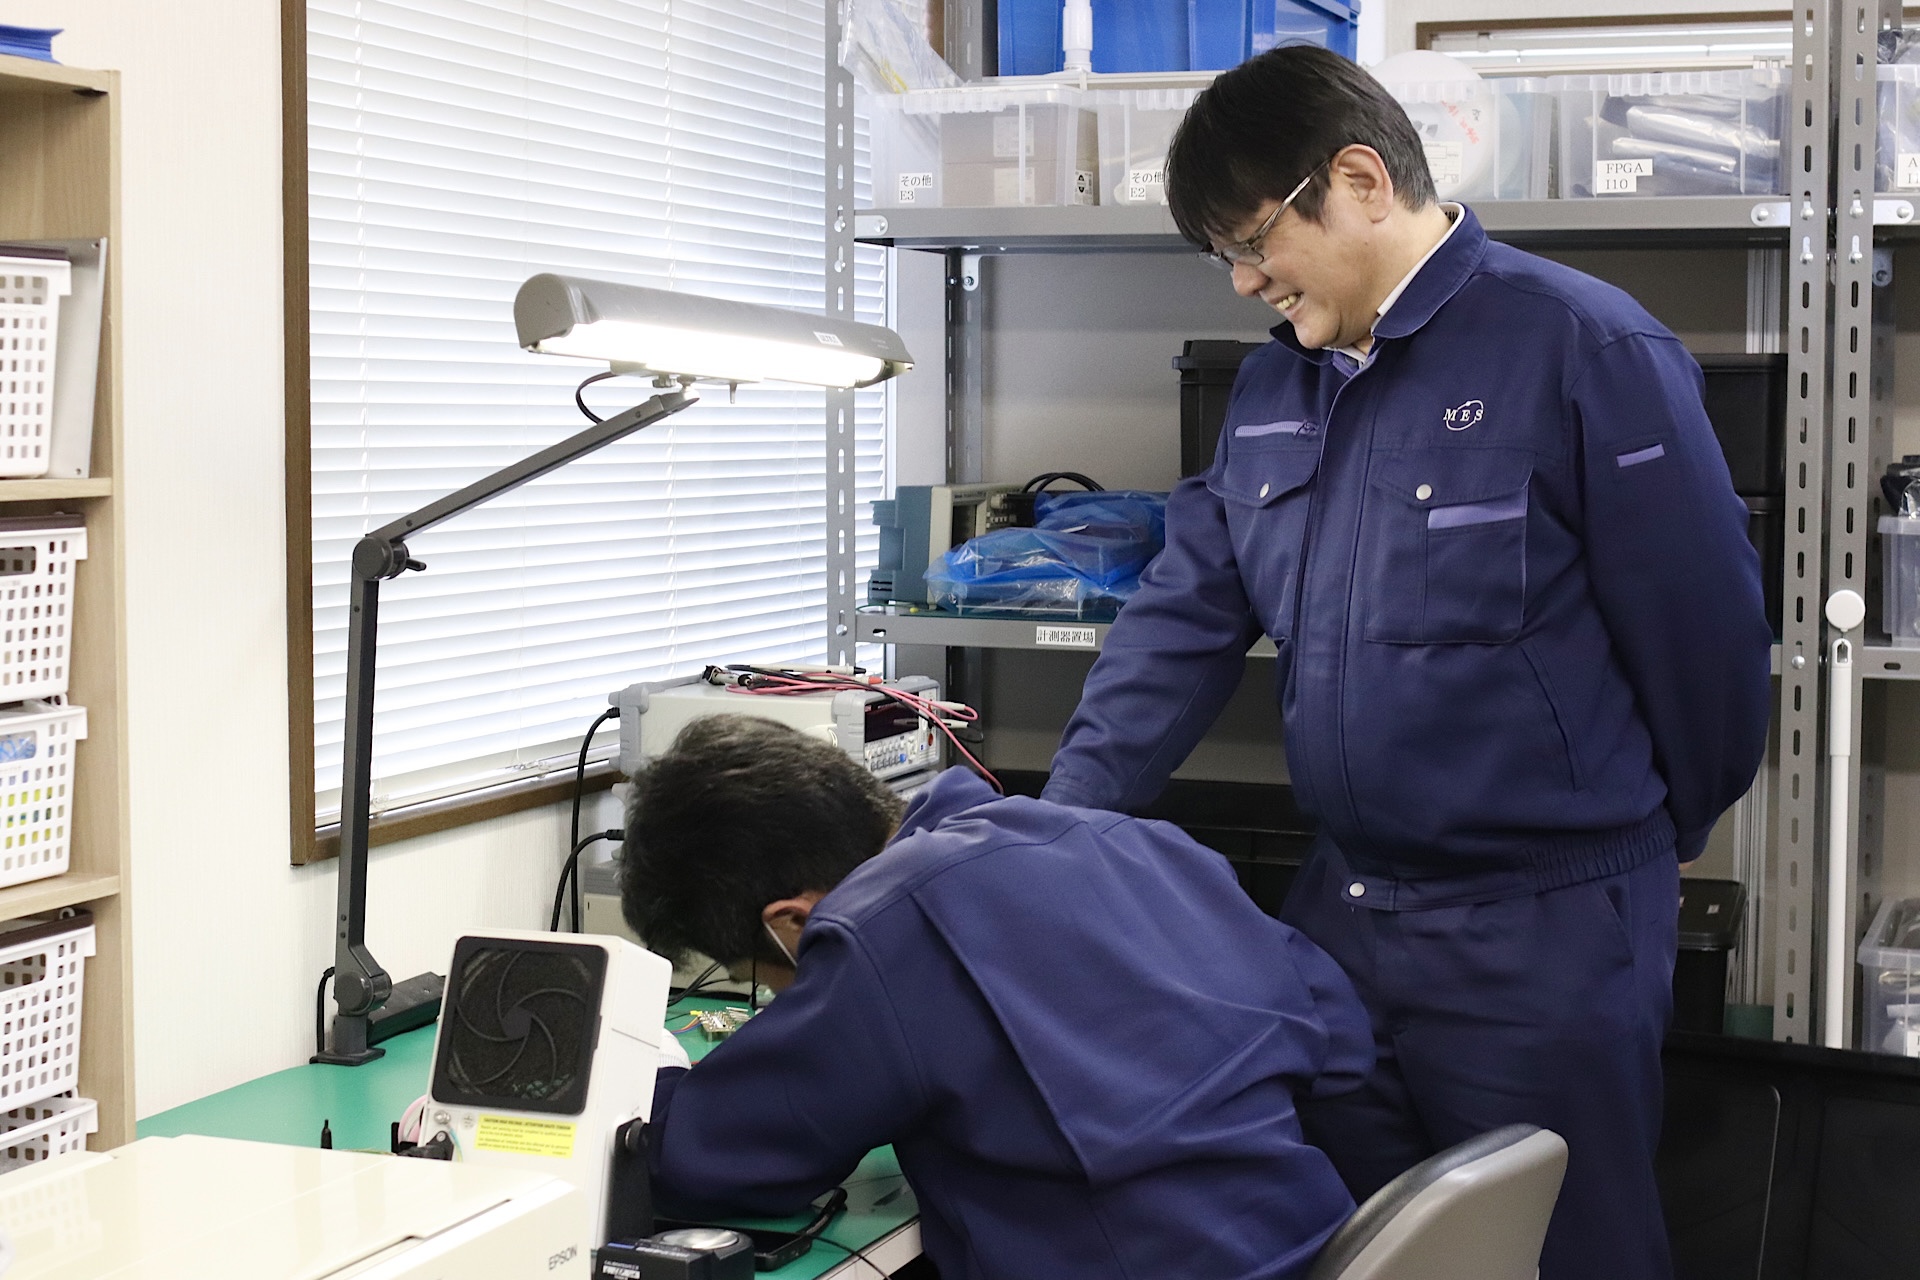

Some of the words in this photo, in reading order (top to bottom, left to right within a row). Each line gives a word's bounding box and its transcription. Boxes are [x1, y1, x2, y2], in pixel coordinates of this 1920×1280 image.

[1606, 162, 1643, 174] FPGA
[901, 174, 932, 187] その他
[900, 190, 914, 201] E3
[1130, 187, 1145, 198] E2
[1443, 408, 1484, 423] MES
[548, 1244, 578, 1271] EPSON
